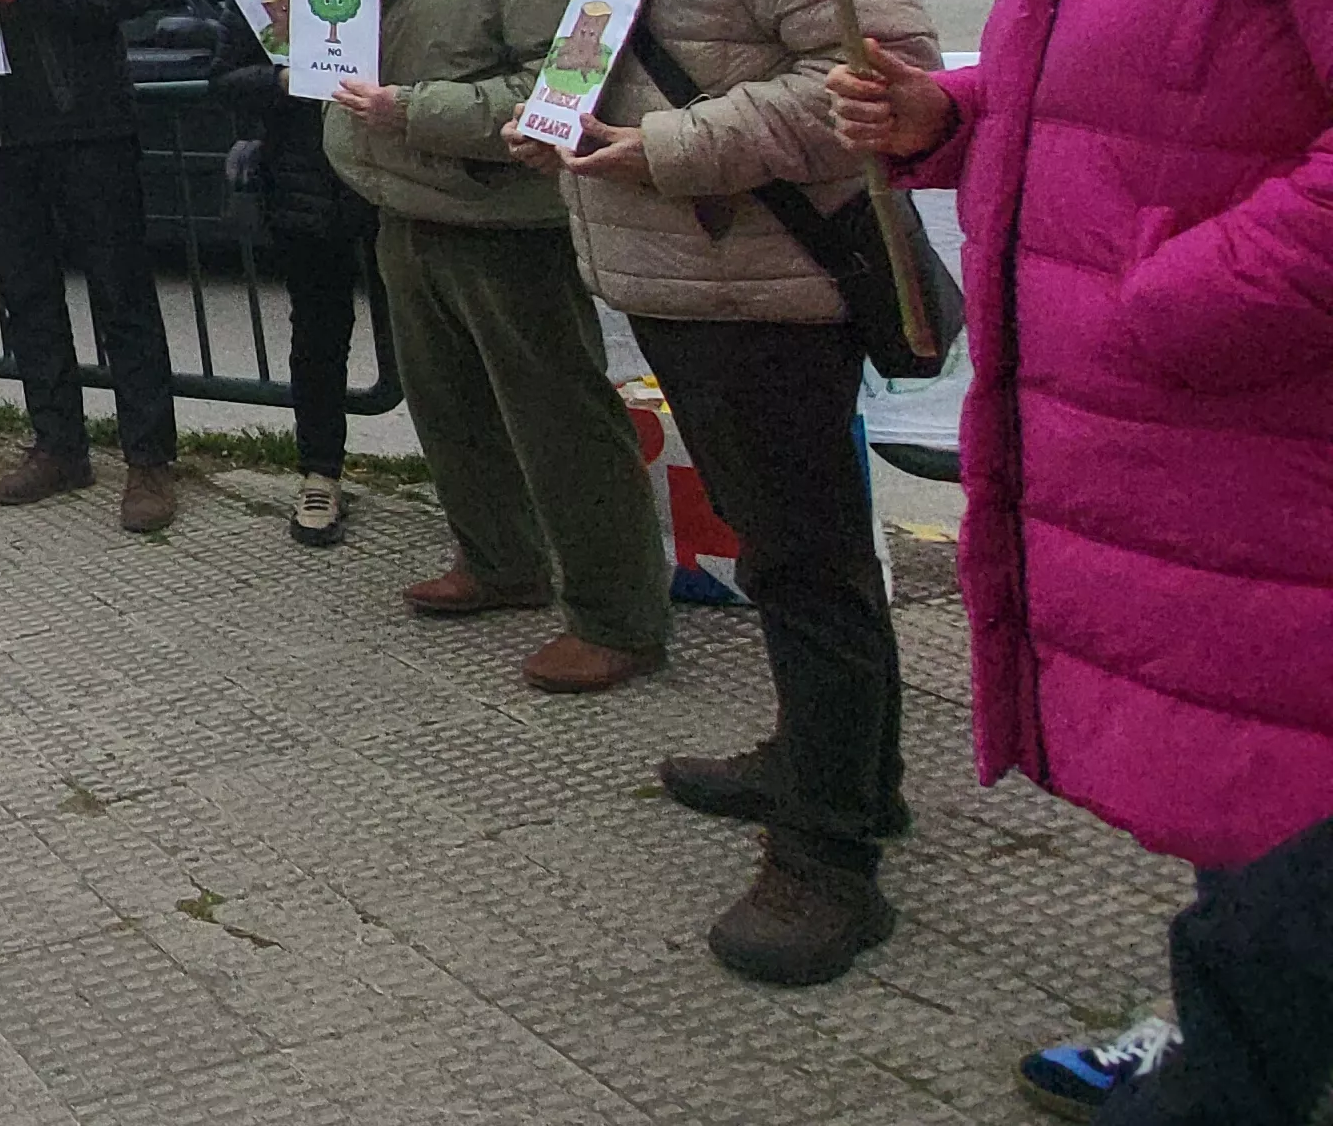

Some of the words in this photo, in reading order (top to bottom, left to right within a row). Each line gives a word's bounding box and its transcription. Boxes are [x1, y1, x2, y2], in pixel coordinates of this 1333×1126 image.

[328, 47, 342, 57] NO
[310, 61, 319, 70] A
[320, 61, 332, 71] LA
[334, 63, 358, 75] TALA
